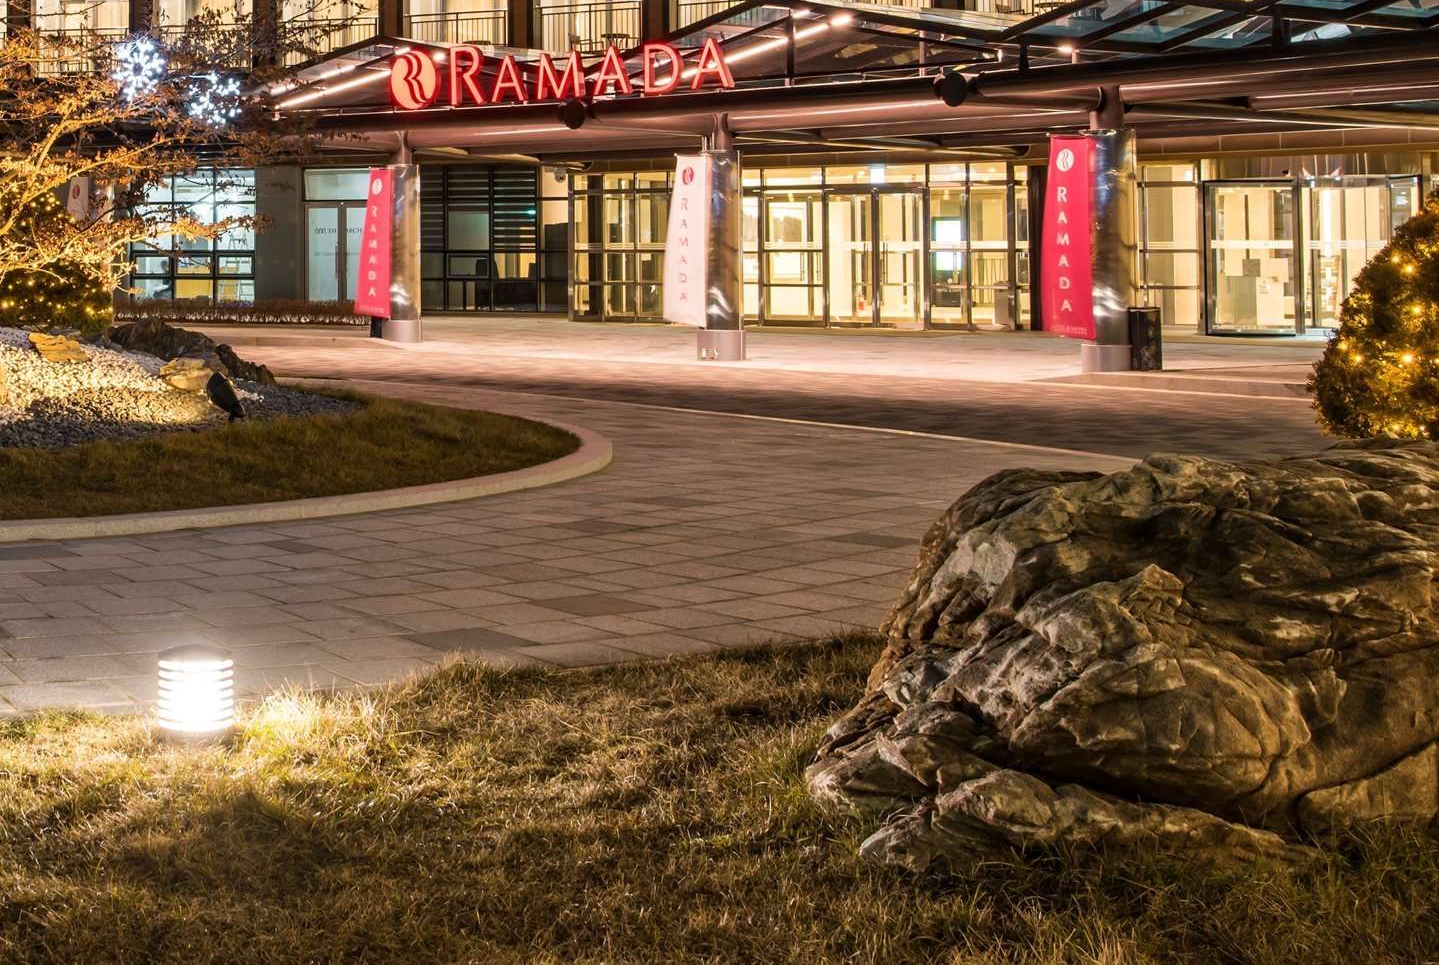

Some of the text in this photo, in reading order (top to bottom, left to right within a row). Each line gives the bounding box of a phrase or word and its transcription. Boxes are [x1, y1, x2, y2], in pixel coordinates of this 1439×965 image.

[449, 37, 735, 106] RAMADA
[368, 205, 378, 297] RAMADA
[679, 198, 689, 301] RAMADA
[1056, 186, 1073, 312] RAMADA
